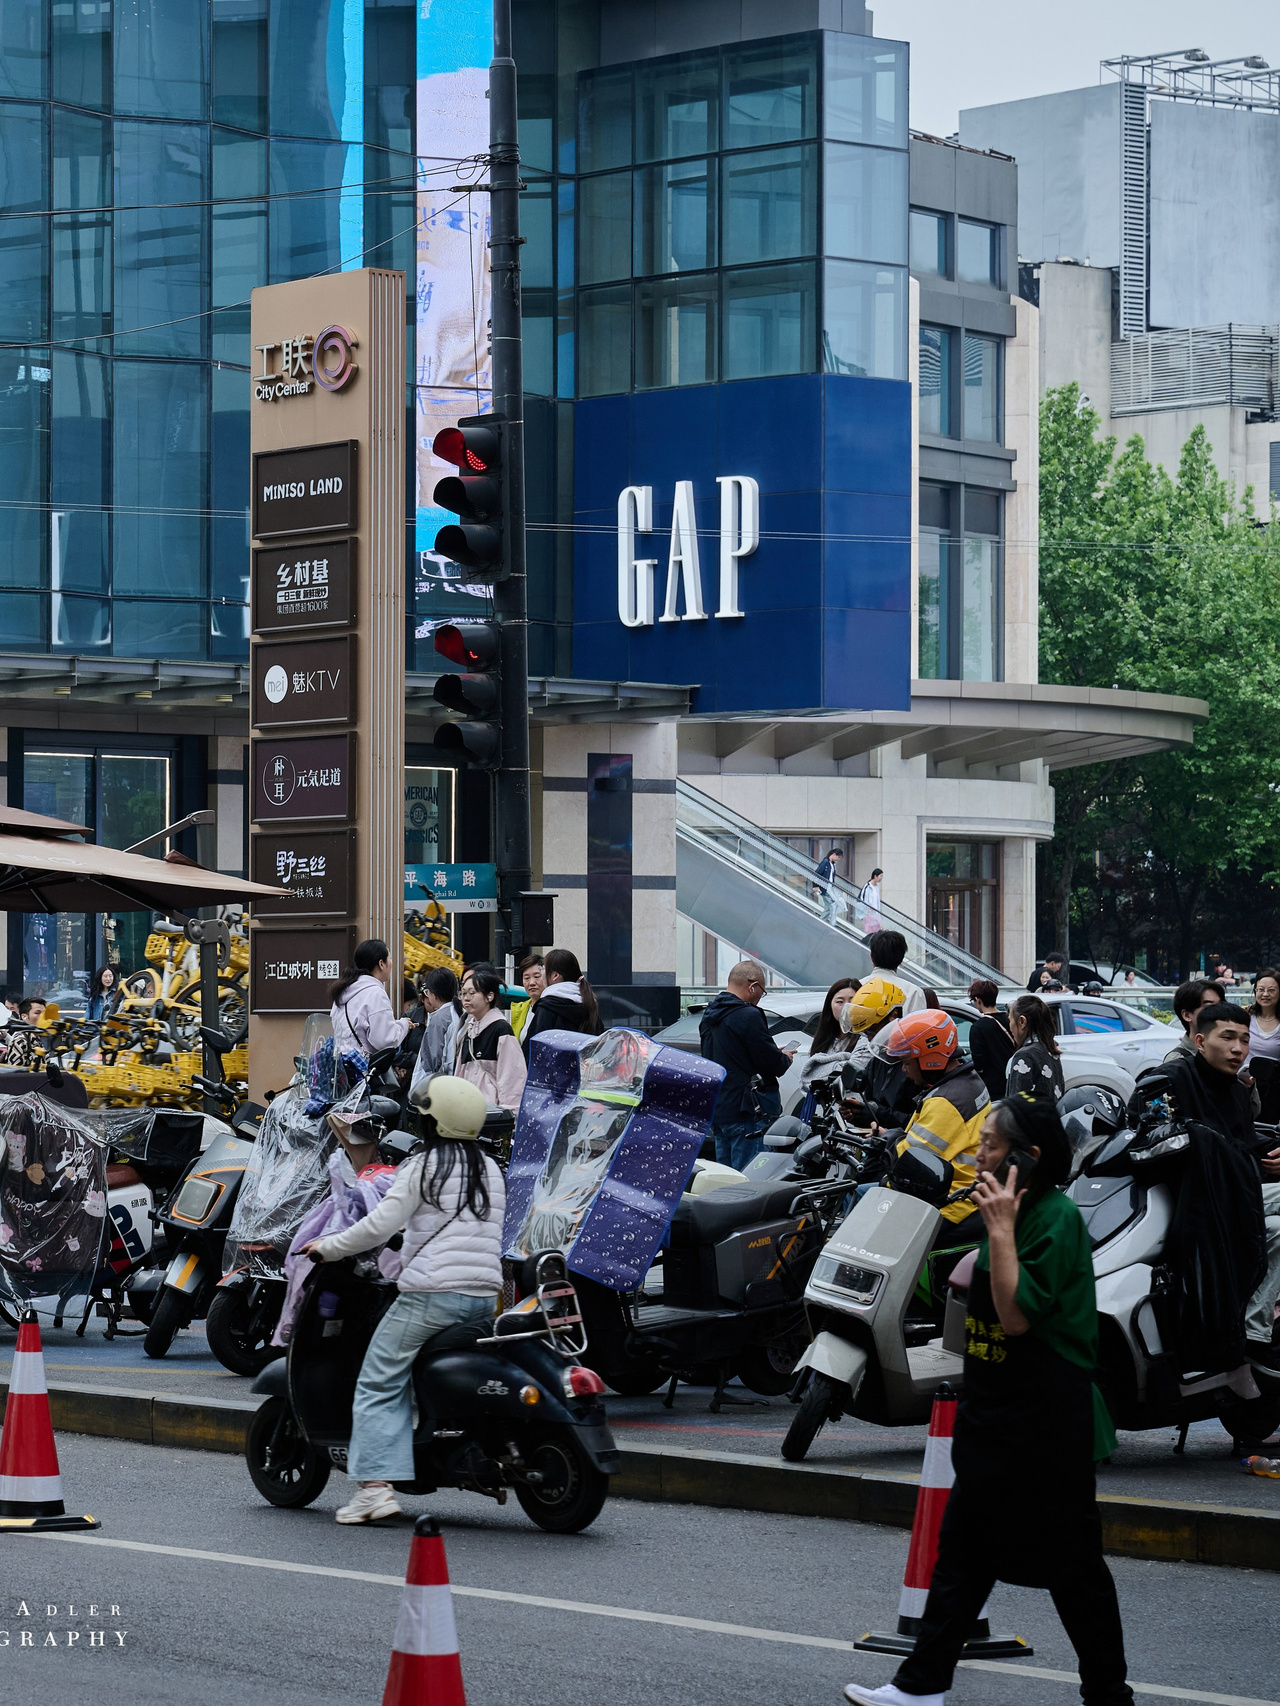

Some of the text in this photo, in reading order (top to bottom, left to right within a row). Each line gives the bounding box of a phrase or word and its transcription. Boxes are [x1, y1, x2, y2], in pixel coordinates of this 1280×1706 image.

[254, 334, 310, 381] 工联
[254, 380, 311, 402] City Center
[263, 477, 343, 502] MINISO LAND
[618, 475, 759, 627] GAP
[276, 558, 329, 588] 乡村基
[267, 676, 285, 693] mei
[292, 669, 341, 694] 魅KTV
[404, 786, 439, 806] MERICAN
[404, 870, 477, 888] 平海路
[264, 960, 315, 980] 江边城外
[6, 1193, 42, 1215] HAPPY
[835, 1242, 857, 1252] AIMA
